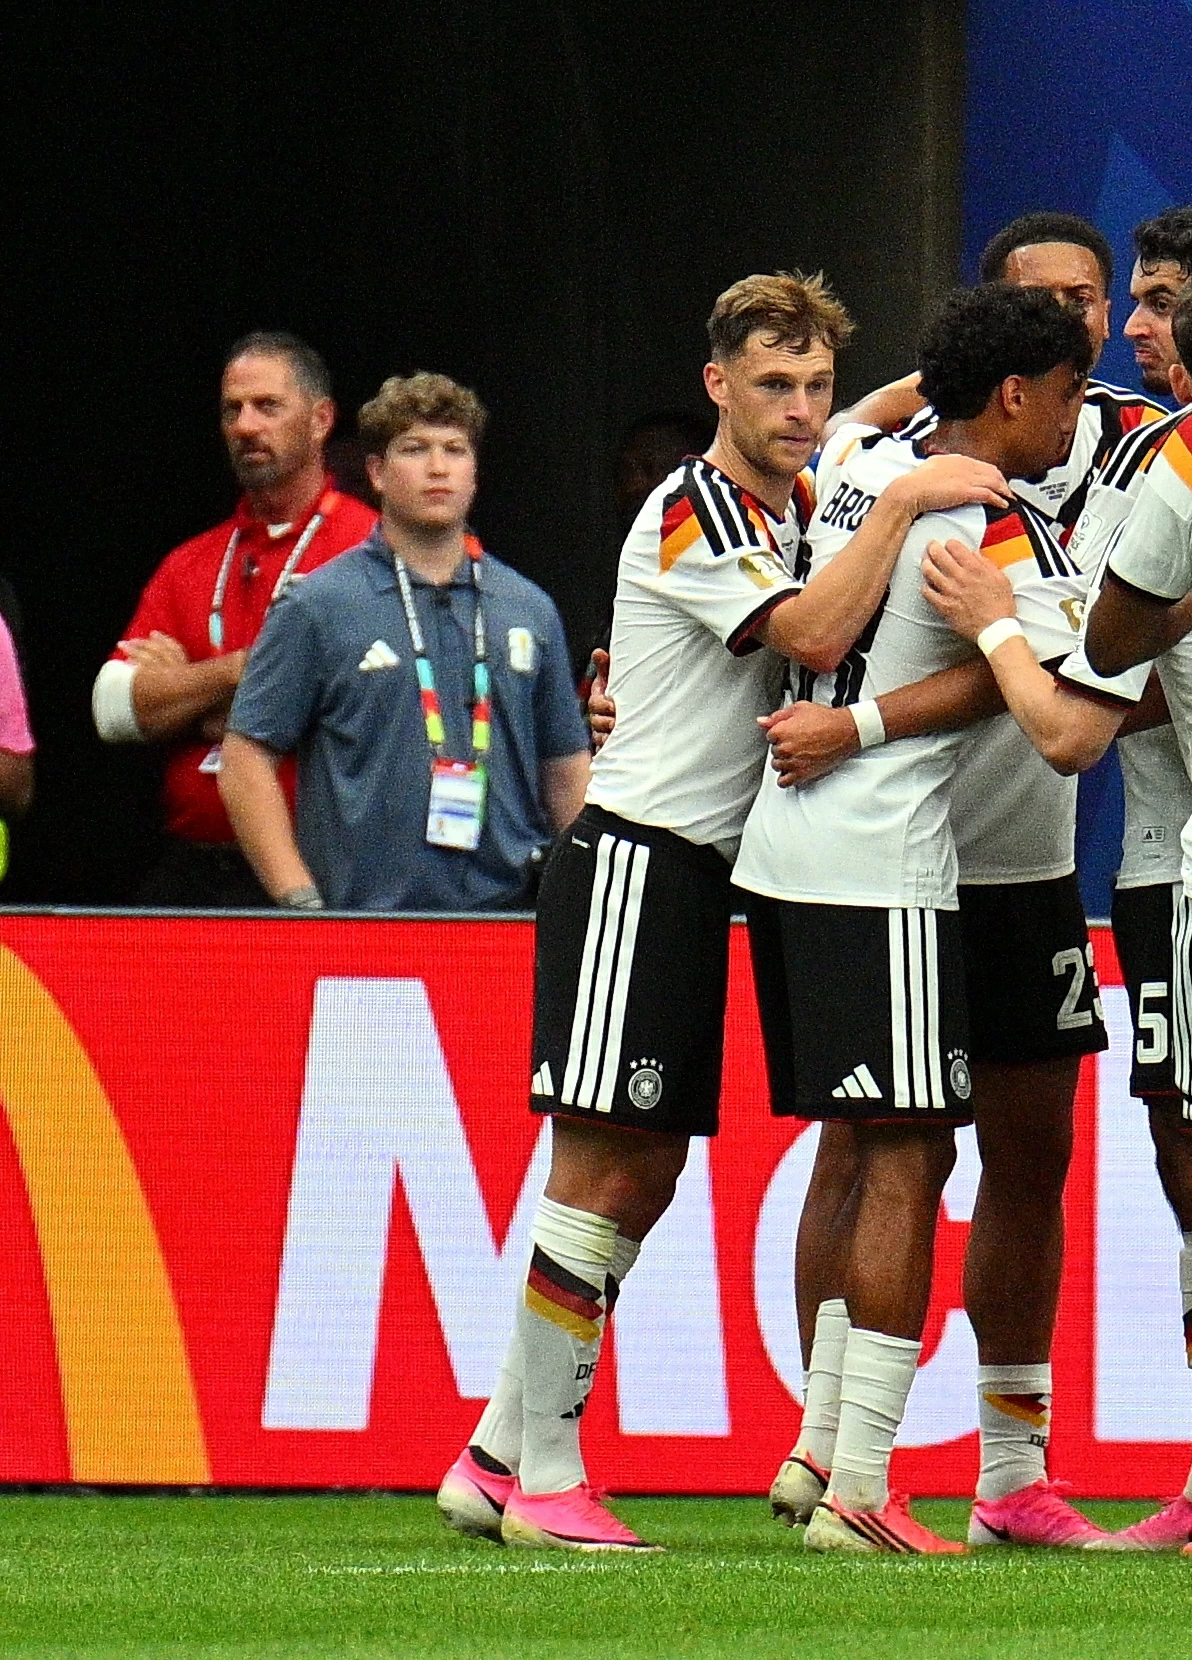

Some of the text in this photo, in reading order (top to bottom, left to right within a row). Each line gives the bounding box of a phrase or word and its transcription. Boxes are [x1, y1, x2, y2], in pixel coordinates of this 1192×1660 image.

[820, 481, 878, 531] BRO
[1136, 982, 1168, 1063] 5
[575, 1361, 599, 1380] DF
[1029, 1433, 1050, 1449] DF
